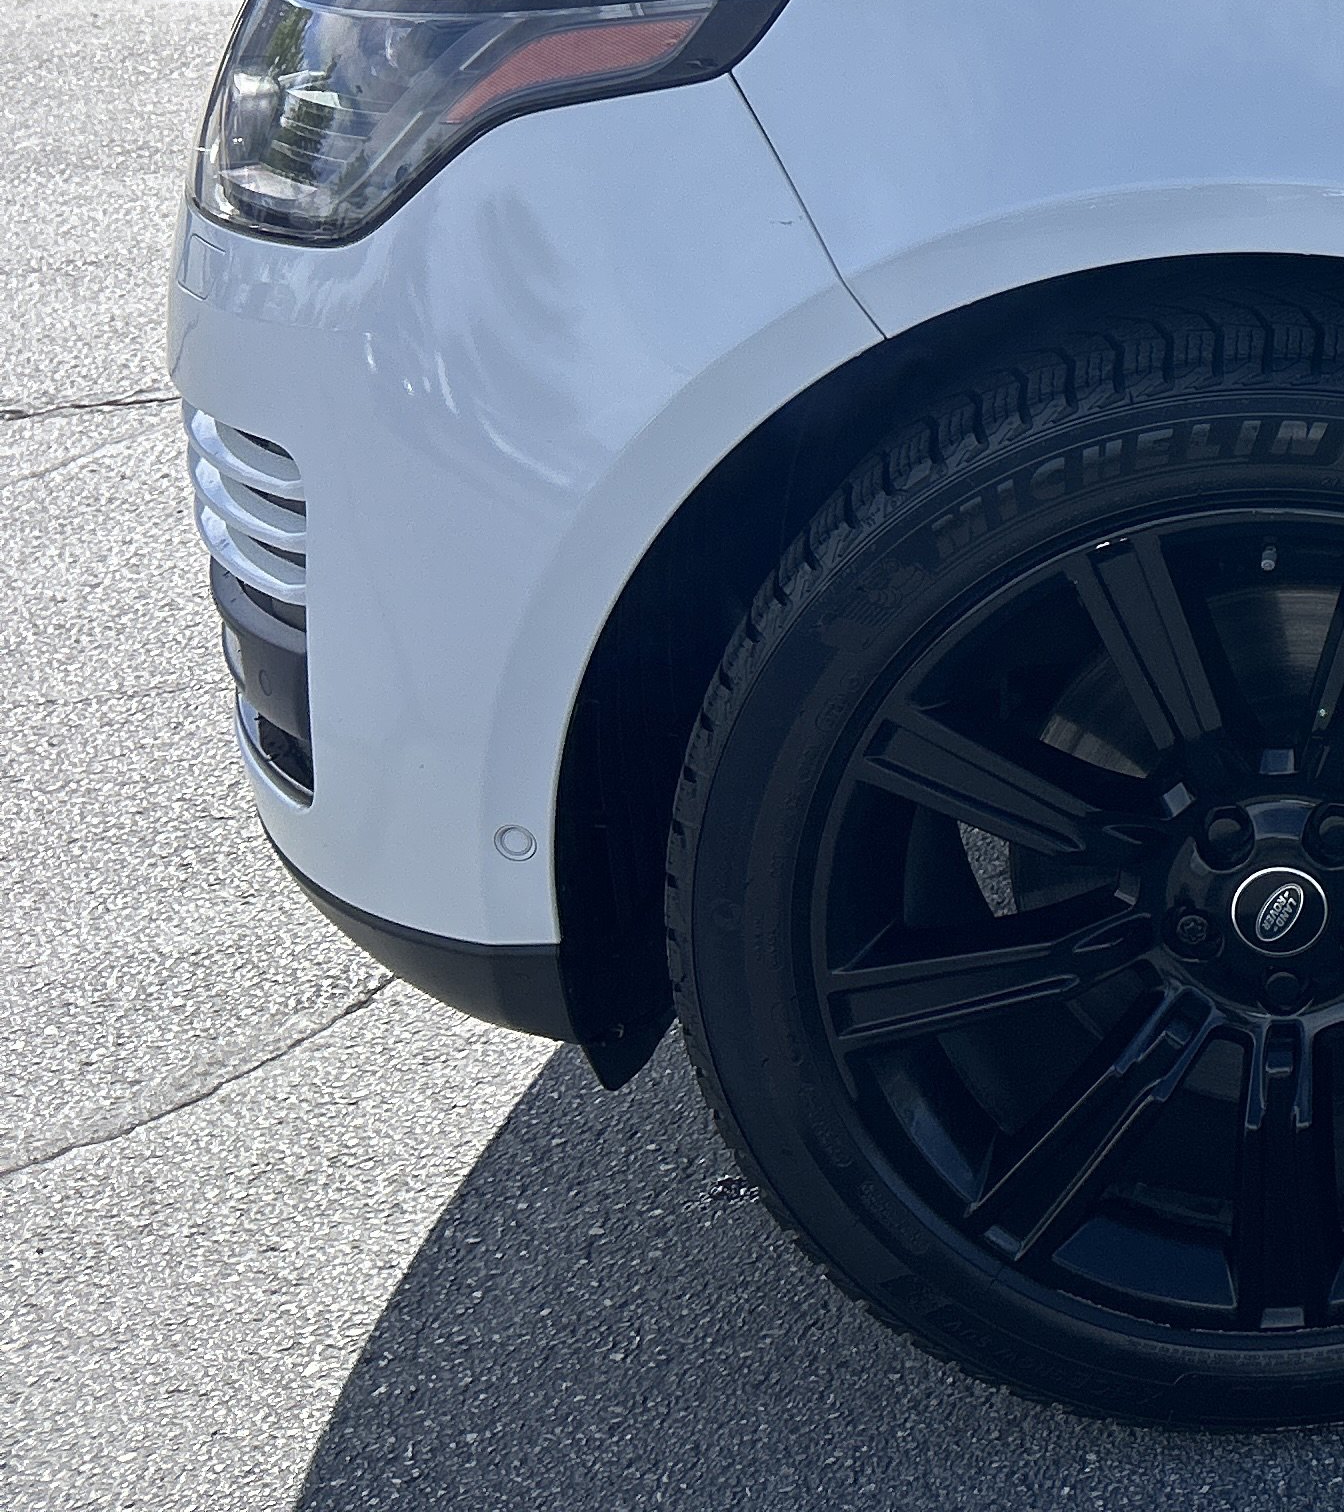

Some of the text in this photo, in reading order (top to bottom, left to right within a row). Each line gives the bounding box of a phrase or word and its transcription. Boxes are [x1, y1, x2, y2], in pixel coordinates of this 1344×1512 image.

[932, 420, 1329, 556] MICHELIN
[1262, 895, 1287, 931] ROVER
[1276, 897, 1297, 927] LAND
